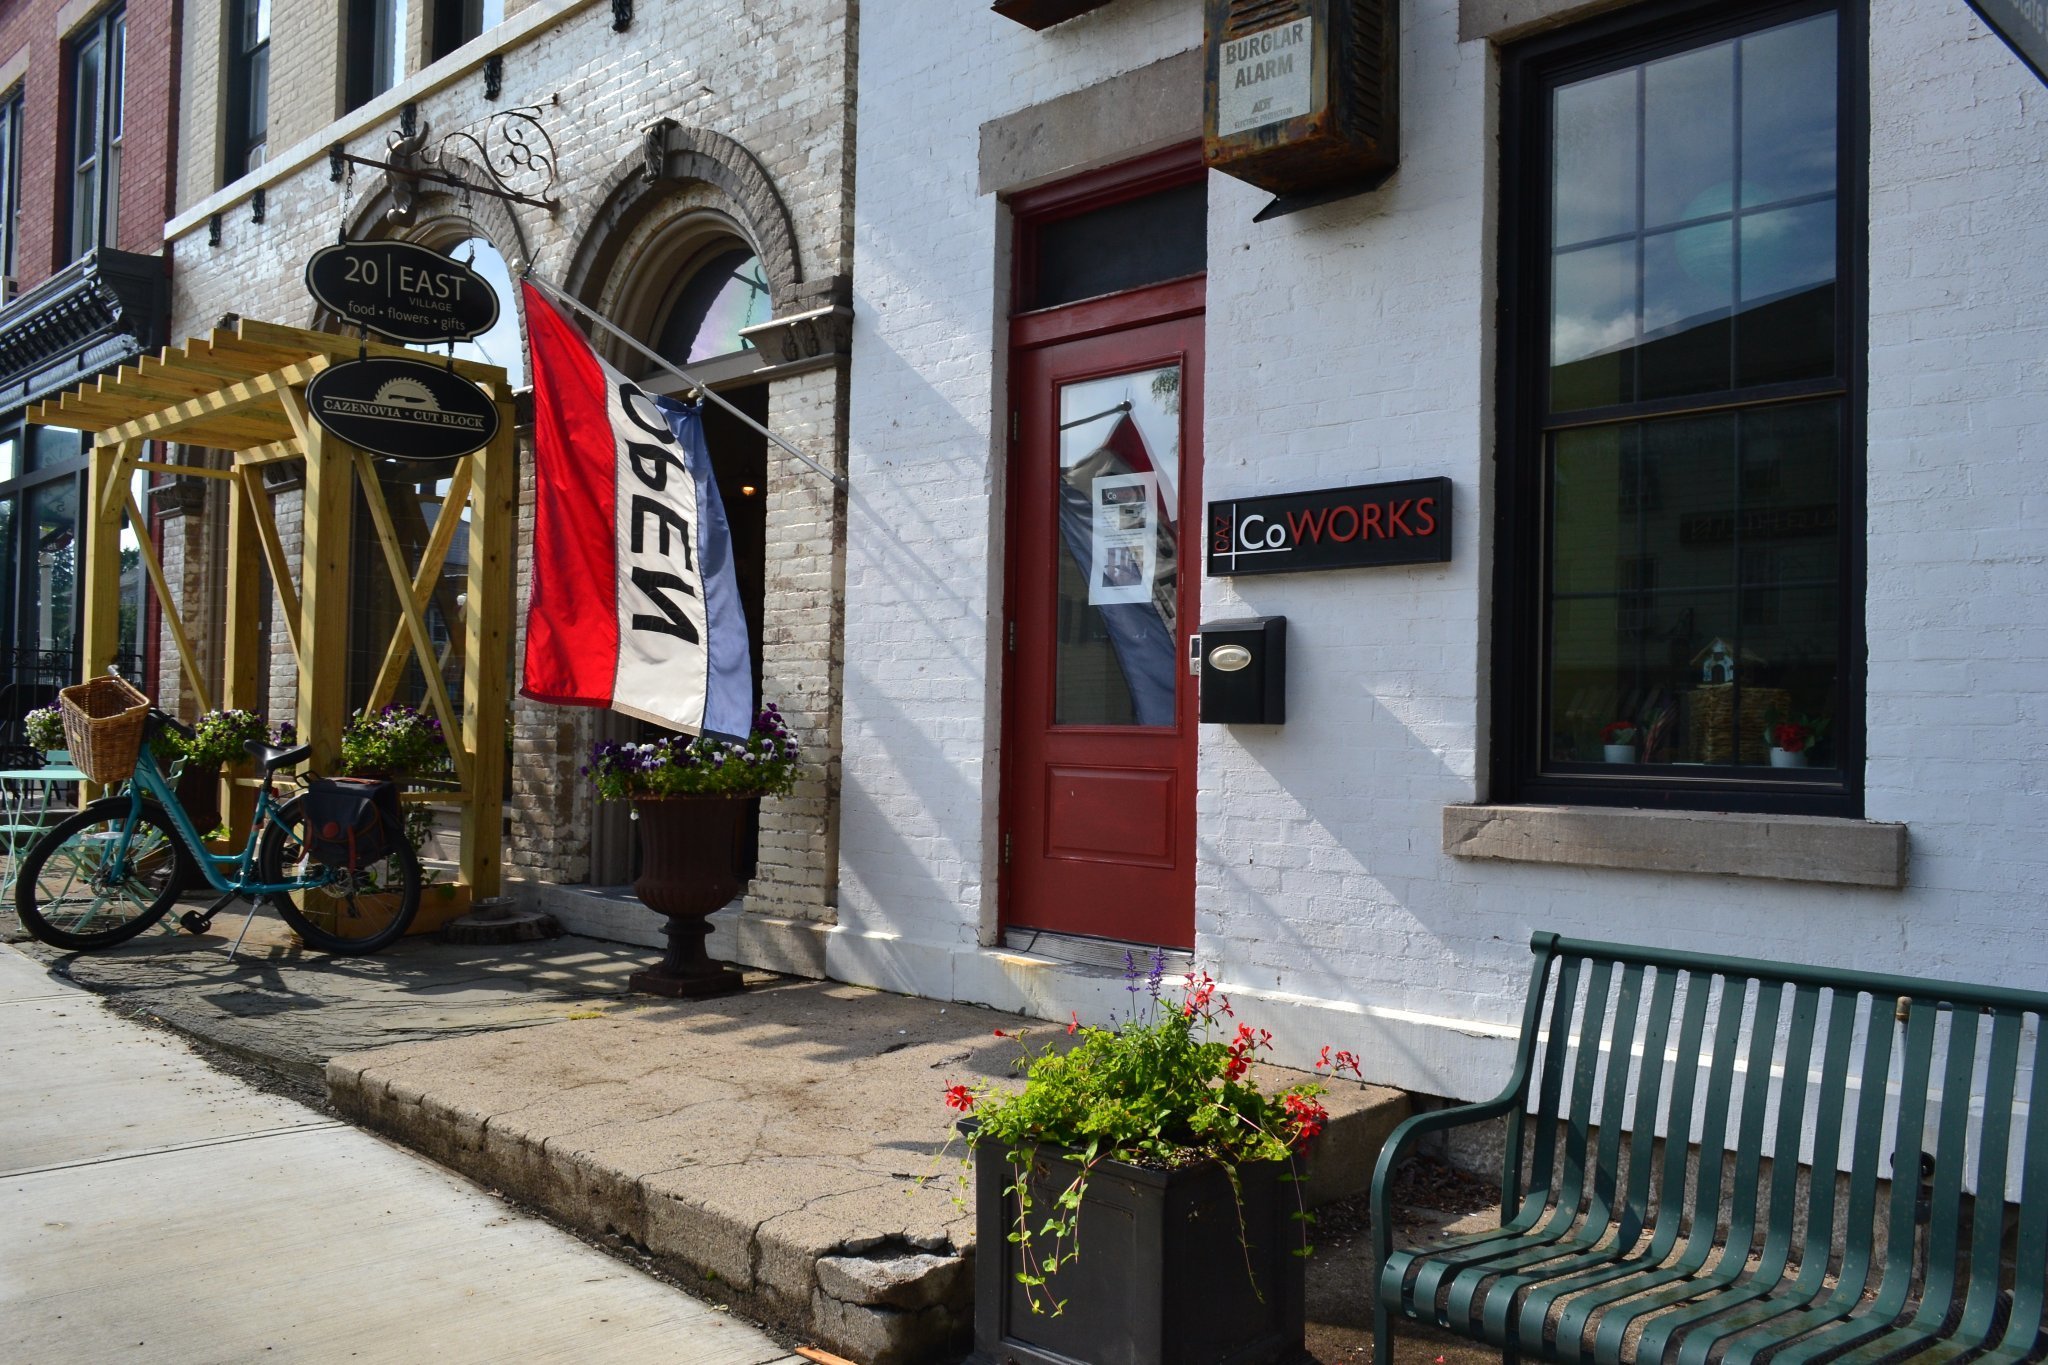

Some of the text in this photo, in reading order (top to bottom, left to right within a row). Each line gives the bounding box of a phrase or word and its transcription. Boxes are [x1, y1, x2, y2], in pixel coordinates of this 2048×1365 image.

[1226, 23, 1303, 65] BURGLAR
[1235, 53, 1293, 89] ALARM
[1251, 96, 1274, 114] ADT
[344, 256, 467, 301] 20 EAST
[348, 300, 466, 331] food flowers gifts
[408, 296, 452, 312] VILLAGE
[323, 399, 484, 428] CAZENOVIA CUT BLOCK
[1214, 516, 1231, 552] CAZ
